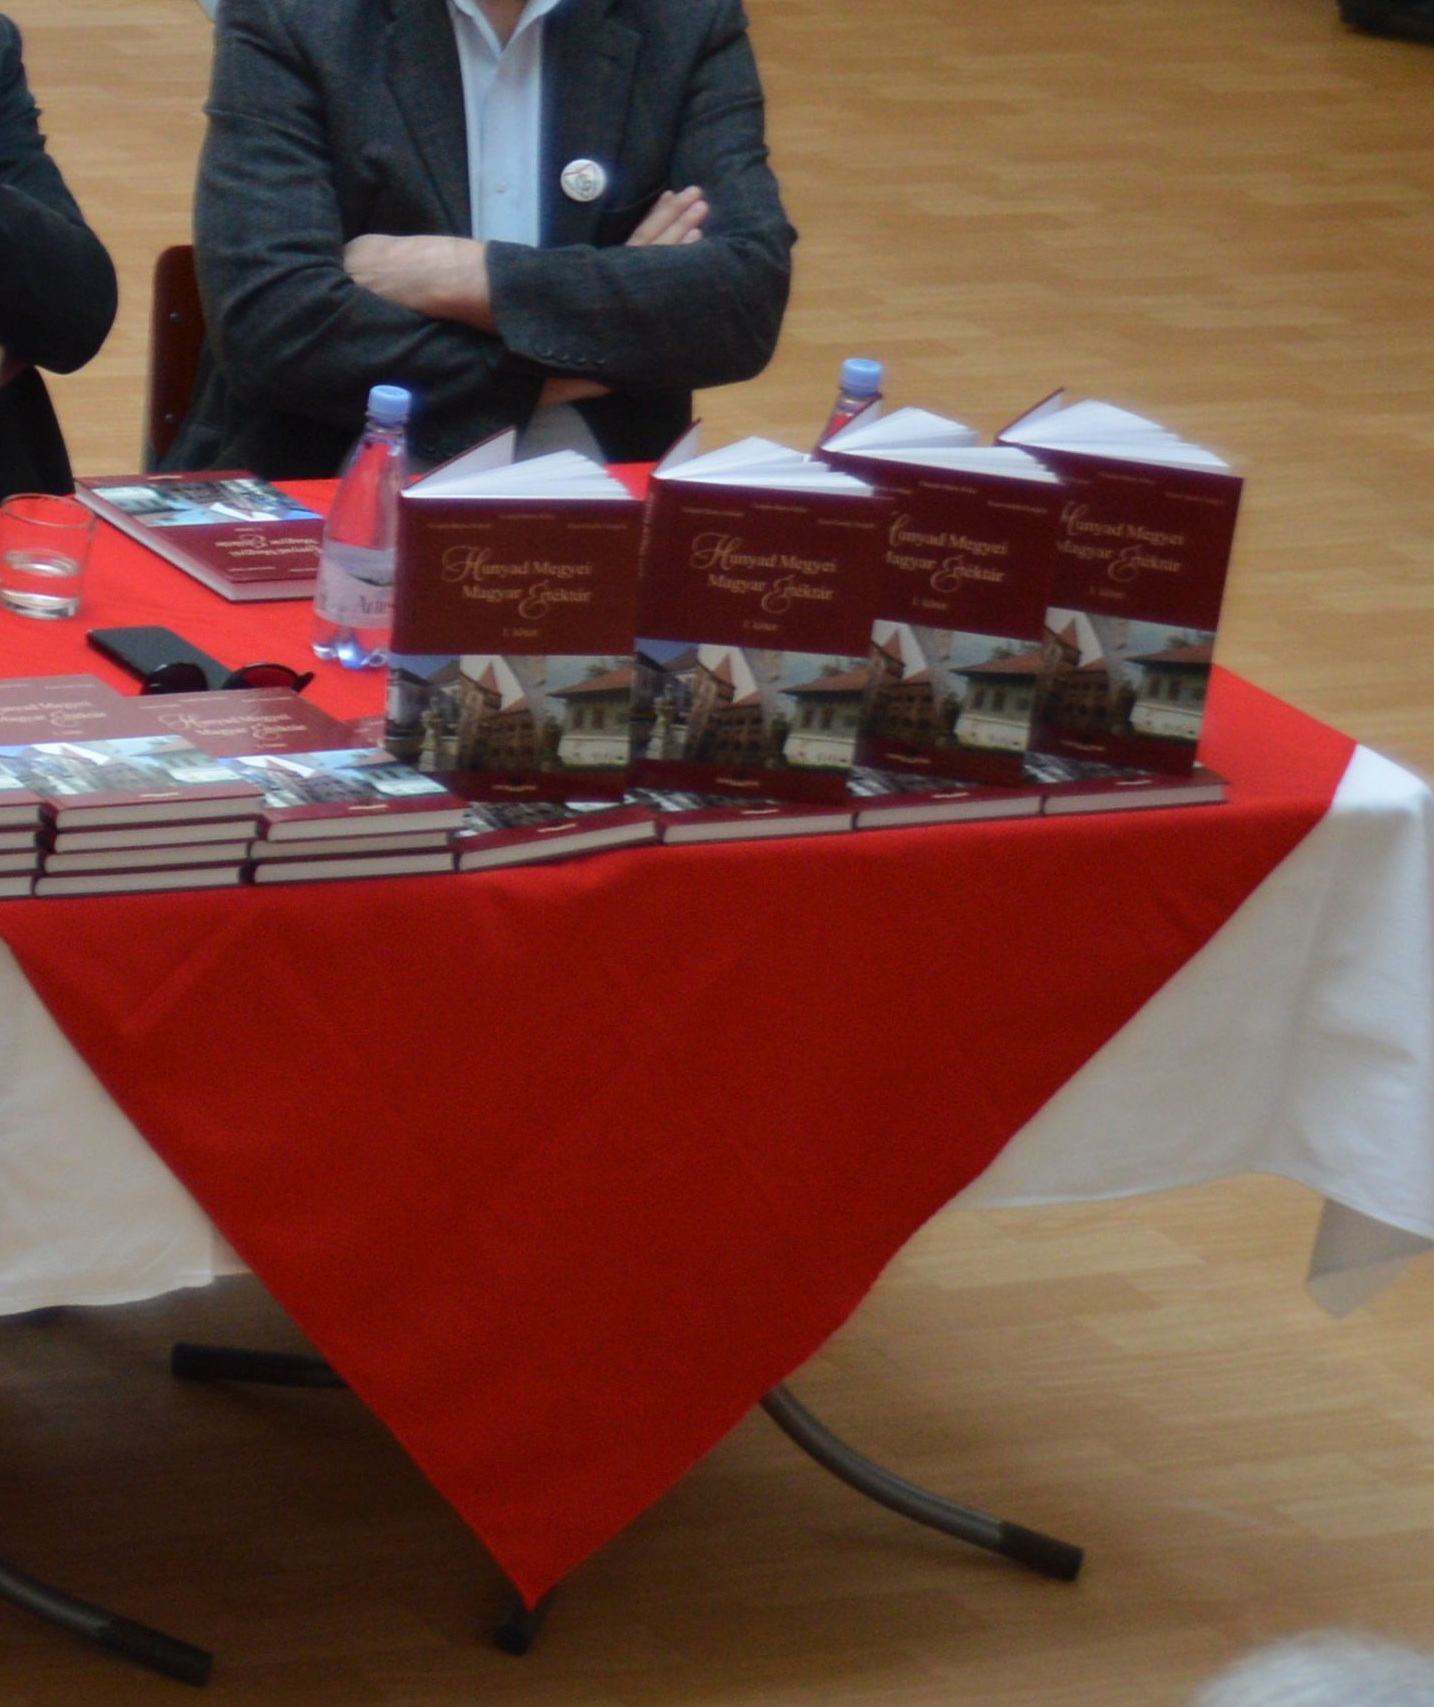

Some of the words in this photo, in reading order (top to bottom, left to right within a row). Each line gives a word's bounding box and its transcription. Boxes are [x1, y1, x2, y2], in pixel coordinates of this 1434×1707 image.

[442, 545, 529, 582] Hunyad
[532, 561, 593, 579] Megyei
[690, 532, 777, 571] Hunyad
[462, 584, 522, 602] Magyar
[707, 573, 767, 593] Magyar
